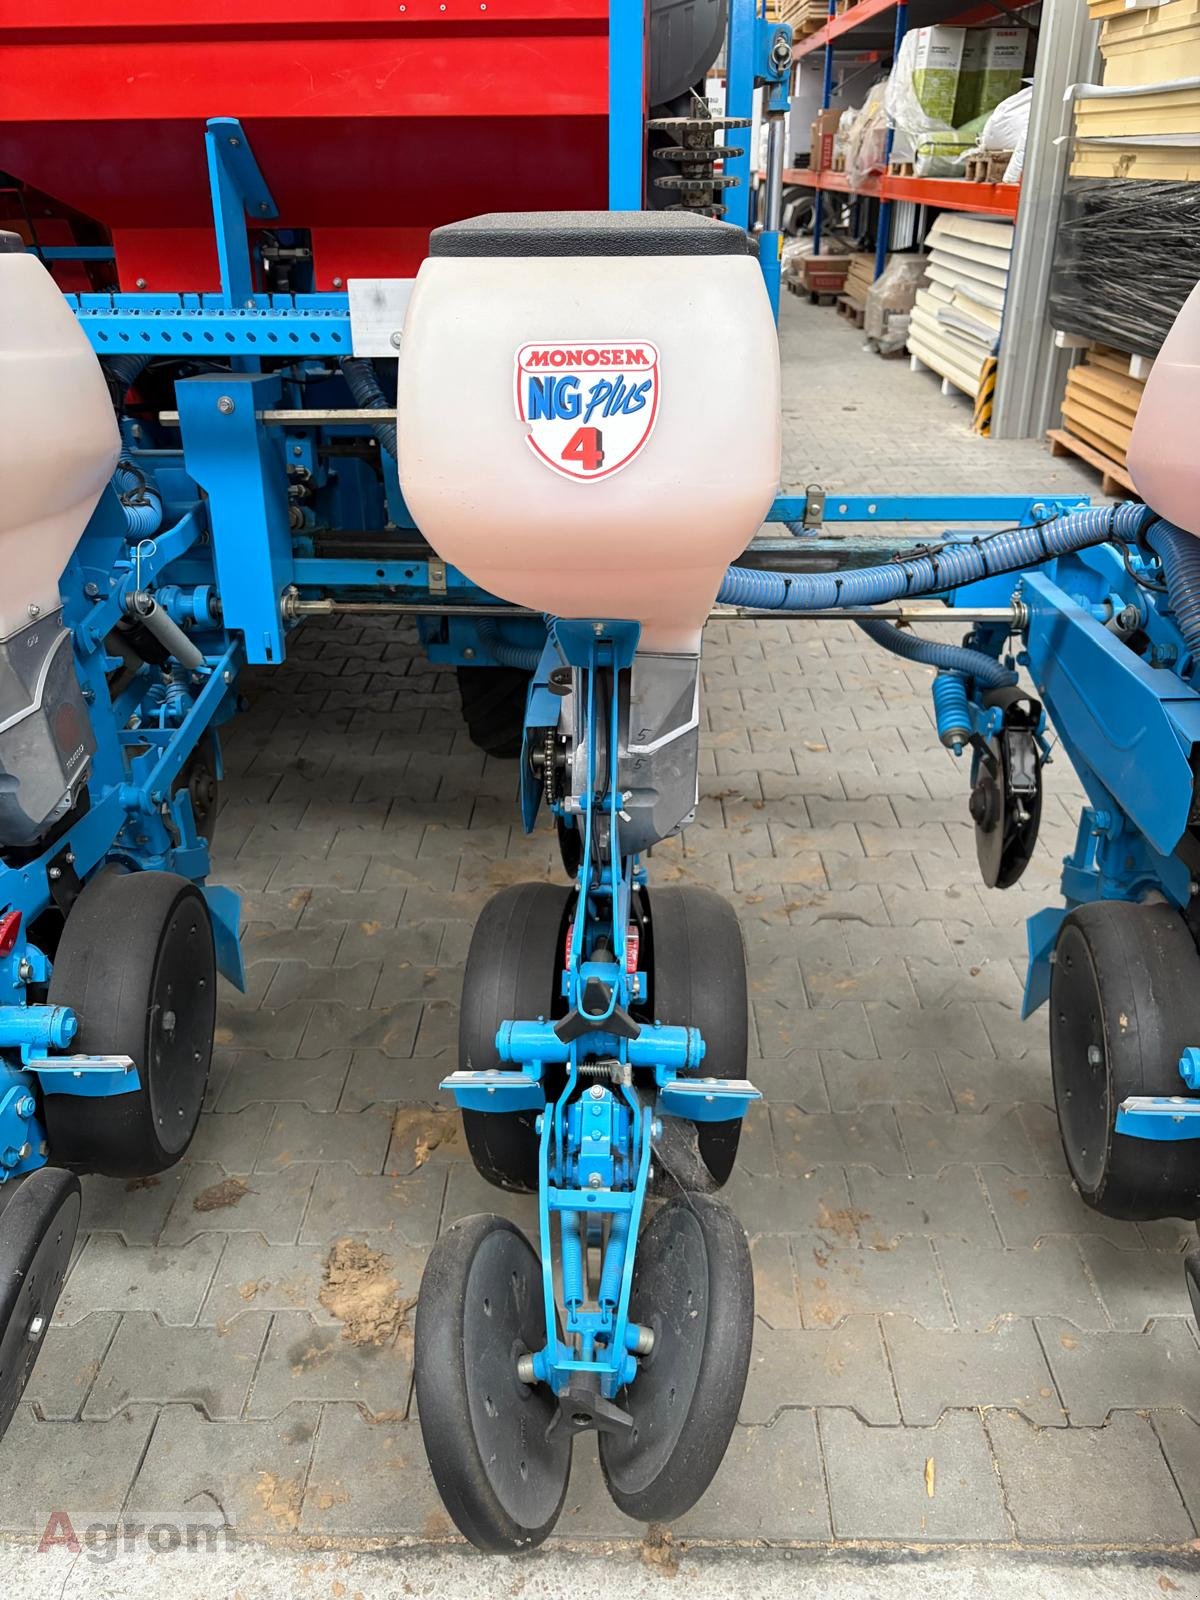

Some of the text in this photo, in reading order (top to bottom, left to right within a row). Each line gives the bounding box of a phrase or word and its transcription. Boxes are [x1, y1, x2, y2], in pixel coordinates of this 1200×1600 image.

[525, 349, 650, 367] MONOSEM
[528, 375, 582, 421] NG
[561, 427, 605, 471] 4
[637, 728, 656, 741] 5
[633, 758, 647, 769] 5
